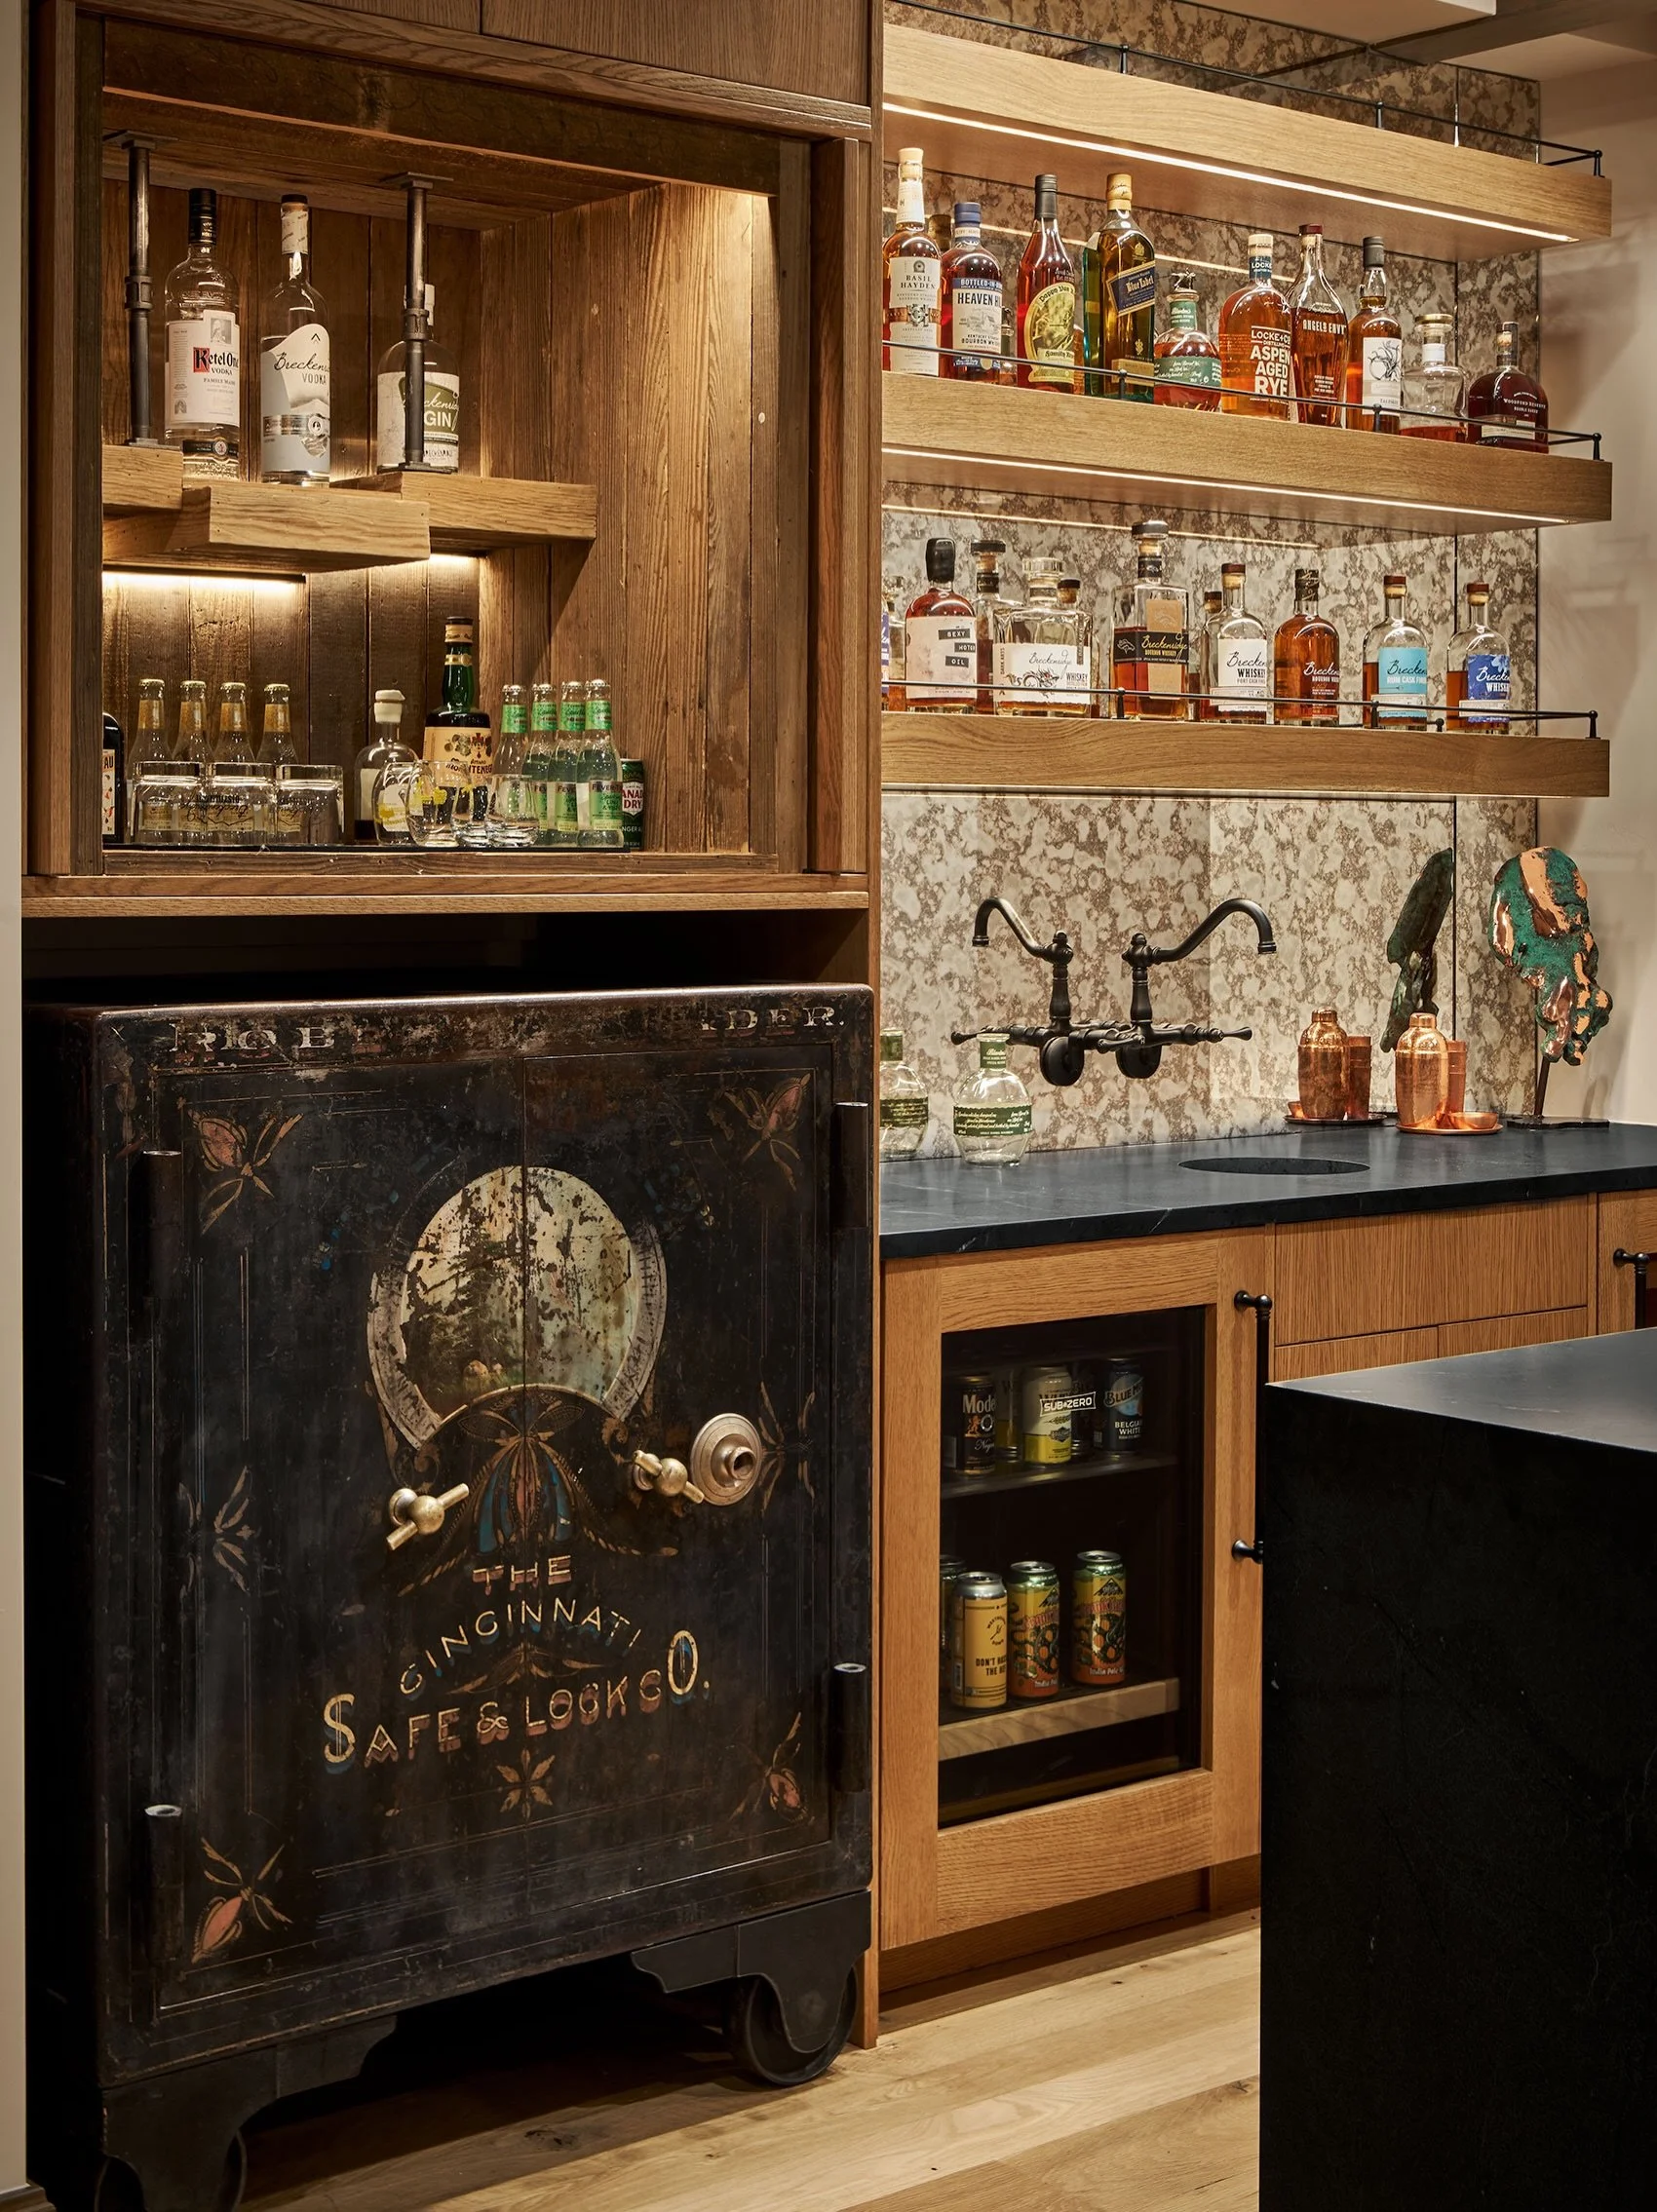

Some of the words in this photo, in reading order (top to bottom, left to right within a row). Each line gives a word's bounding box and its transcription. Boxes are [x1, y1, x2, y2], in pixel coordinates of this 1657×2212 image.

[1126, 280, 1140, 293] Blue
[1139, 275, 1154, 288] Label
[957, 292, 993, 306] HEAVEN
[195, 348, 226, 372] Ketel
[1250, 345, 1291, 365] ASPEN
[1255, 361, 1289, 378] AGED
[1254, 375, 1288, 398] RYE
[424, 410, 451, 428] GIN
[1141, 632, 1188, 665] Breckenridge
[1066, 672, 1088, 682] WHISKEY
[624, 799, 642, 809] DRY
[1104, 1390, 1133, 1408] BLUE
[472, 1555, 572, 1594] THE
[399, 1598, 642, 1697] CINCINNATI
[976, 1658, 996, 1667] DON'T
[985, 1666, 998, 1676] THE
[323, 1693, 462, 1769] SAFE
[476, 1700, 510, 1744] &
[524, 1675, 629, 1736] LOCK
